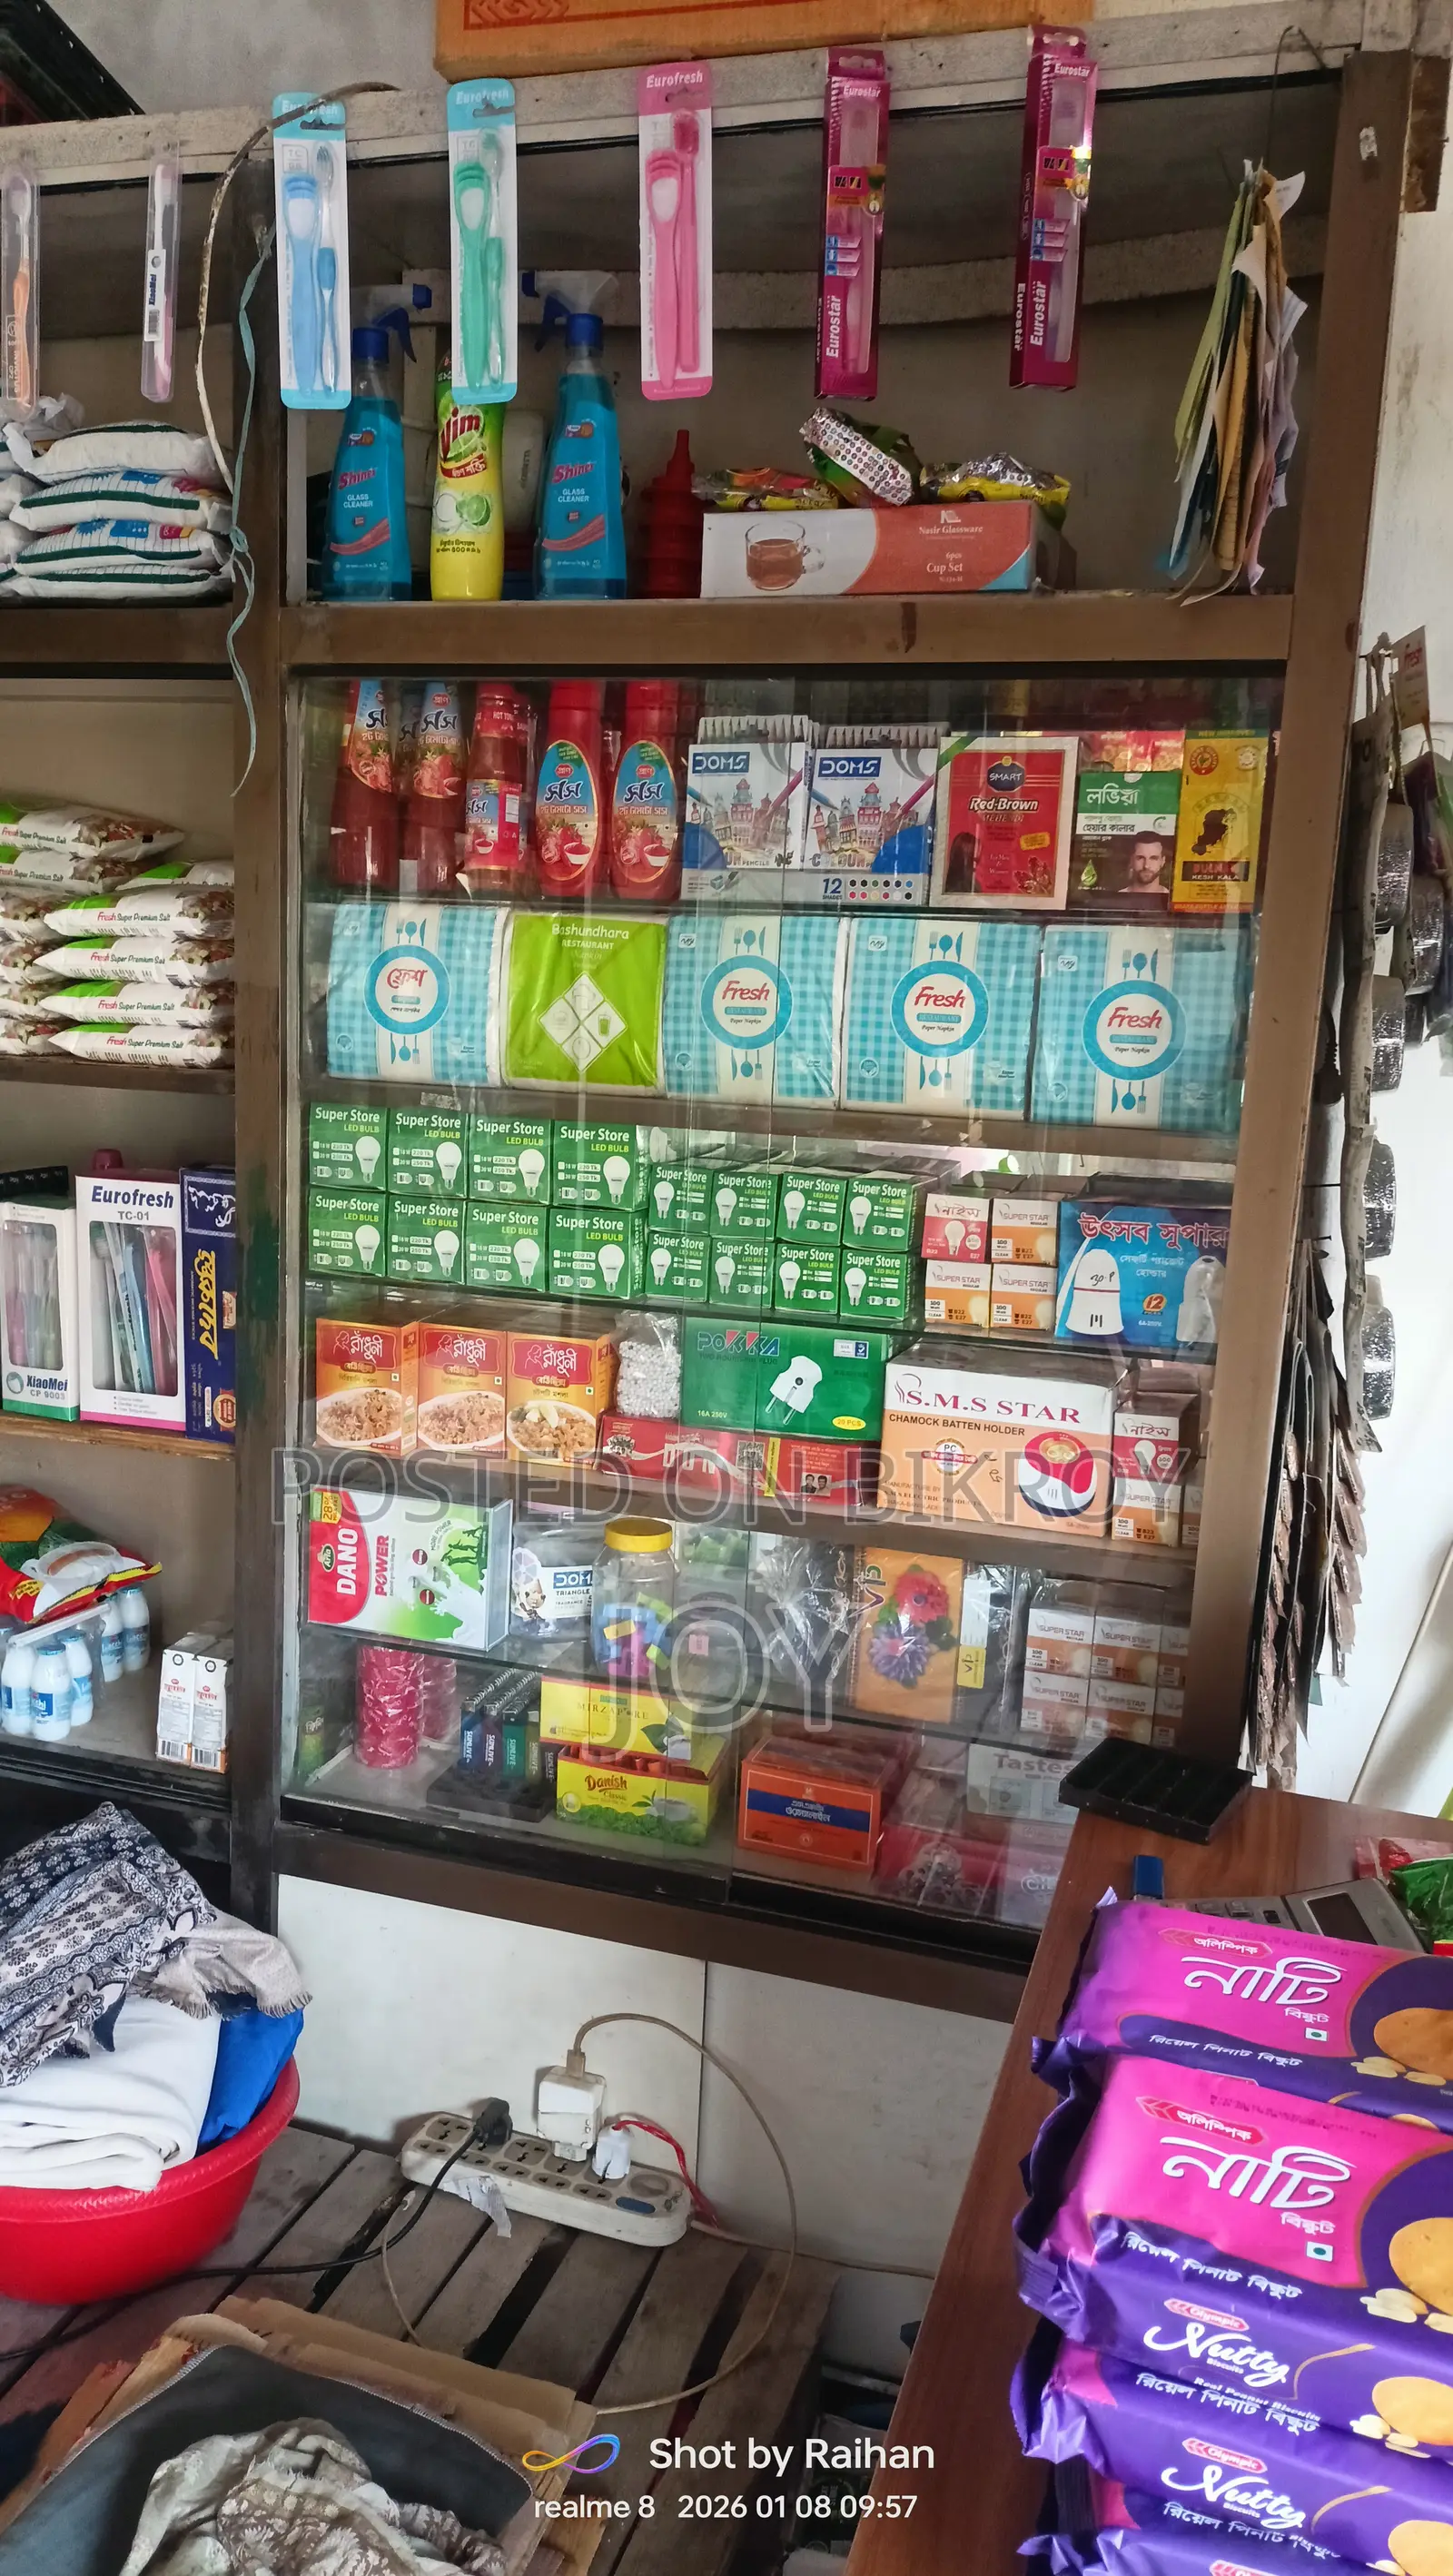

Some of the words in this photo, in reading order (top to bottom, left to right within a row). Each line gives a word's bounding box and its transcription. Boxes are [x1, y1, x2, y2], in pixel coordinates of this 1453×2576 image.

[647, 70, 703, 89] Eurofresh
[440, 407, 479, 463] Vim
[343, 500, 373, 508] CLEANER
[558, 495, 589, 503] CLEANER
[919, 525, 940, 534] Nasir
[943, 525, 983, 534] Glassware
[926, 563, 946, 574] Cup
[948, 563, 963, 572] Set
[695, 755, 747, 771] DOMS
[819, 759, 877, 775] DOMS
[989, 772, 1023, 782] SMART
[545, 779, 583, 803] সস
[623, 780, 665, 803] সস
[970, 797, 1039, 812] Red-Brown
[1109, 824, 1135, 834] কালার
[823, 878, 842, 894] 12
[97, 912, 116, 921] Fresh
[117, 913, 133, 923] Super
[133, 912, 158, 922] Premium
[159, 912, 171, 922] Salt
[552, 923, 629, 941] Bashundhara
[561, 940, 615, 951] RESTAURANT
[387, 967, 427, 991] ফ্রেশ
[721, 981, 770, 1002] Fresh
[914, 986, 966, 1010] Fresh
[98, 999, 118, 1010] Fresh
[118, 1002, 135, 1012] Super
[136, 1002, 162, 1012] Premium
[163, 1002, 174, 1012] Salt
[1108, 1006, 1162, 1030] Fresh
[922, 1024, 935, 1032] Paper
[936, 1024, 955, 1032] Napkin
[107, 1036, 127, 1046] Fresh
[127, 1039, 143, 1047] Super
[145, 1039, 170, 1049] Premium
[171, 1040, 183, 1050] Salt
[315, 1108, 348, 1124] Super
[351, 1109, 380, 1123] Store
[396, 1113, 429, 1128] Super
[430, 1116, 461, 1129] Store
[476, 1120, 509, 1135] Super
[511, 1121, 544, 1135] Store
[560, 1126, 592, 1143] Super
[595, 1128, 629, 1142] Store
[506, 1137, 519, 1145] LED
[521, 1138, 544, 1146] BULB
[91, 1186, 173, 1209] Eurofresh
[315, 1196, 348, 1211] Super
[351, 1198, 380, 1212] Store
[118, 1210, 149, 1221] TC-01
[394, 1201, 427, 1218] Super
[430, 1204, 459, 1217] Store
[472, 1209, 504, 1226] Super
[507, 1212, 539, 1225] Store
[942, 1204, 981, 1218] নাইস
[1003, 1212, 1028, 1220] SUPER
[556, 1215, 588, 1231] Super
[589, 1217, 624, 1230] Store
[1077, 1211, 1153, 1245] উৎসব
[962, 1276, 981, 1284] STAR
[1145, 1295, 1164, 1309] 12
[351, 1330, 383, 1363] রাঁধুনী
[453, 1333, 487, 1367] রাঁধুনী
[697, 1329, 781, 1357] POKKA
[542, 1343, 578, 1378] রাঁধুনী
[26, 1374, 68, 1392] XiaoMei
[697, 1409, 710, 1417] 16A
[712, 1410, 728, 1418] 250V
[906, 1389, 987, 1413] S.M.S
[996, 1400, 1081, 1424] STAR
[837, 1418, 846, 1426] 20
[847, 1419, 862, 1427] PCS
[888, 1413, 939, 1427] CHAMOCK
[942, 1418, 981, 1432] BATTEN
[983, 1424, 1025, 1436] HOLDER
[1126, 1420, 1171, 1438] নাইস
[944, 1444, 957, 1453] PC
[336, 1527, 359, 1596] DANO
[374, 1535, 390, 1597] POWER
[585, 1774, 628, 1791] Danish
[603, 1791, 627, 1801] Classic
[1193, 1937, 1259, 1955] অলিম্পিক
[1181, 1956, 1348, 2006] নাটি
[1284, 2008, 1329, 2024] বিস্কুট
[1149, 2034, 1198, 2050] রিয়েল
[1202, 2041, 1253, 2059] পিনাট
[1257, 2050, 1303, 2068] বিস্কুট
[1176, 2108, 1252, 2142] অলিম্পিক
[1160, 2137, 1357, 2209] নাটি
[1280, 2212, 1336, 2235] বিস্কুট
[1122, 2231, 1178, 2264] রিয়েল
[1181, 2257, 1242, 2284] পিনাট
[1247, 2275, 1303, 2300] বিস্কুট
[1190, 2305, 1240, 2329] Olympic
[1143, 2322, 1291, 2387] Nutty
[1206, 2357, 1244, 2374] Biscuits
[1136, 2374, 1196, 2399] রিয়েল
[1201, 2391, 1260, 2415] পিনাট
[1265, 2407, 1320, 2435] বিস্কুট
[1207, 2446, 1260, 2471] Olympic
[1161, 2464, 1307, 2530] Nutty
[1223, 2502, 1260, 2519] Biscuits
[1163, 2502, 1222, 2530] রিয়েল
[1228, 2519, 1284, 2544] পিনাট
